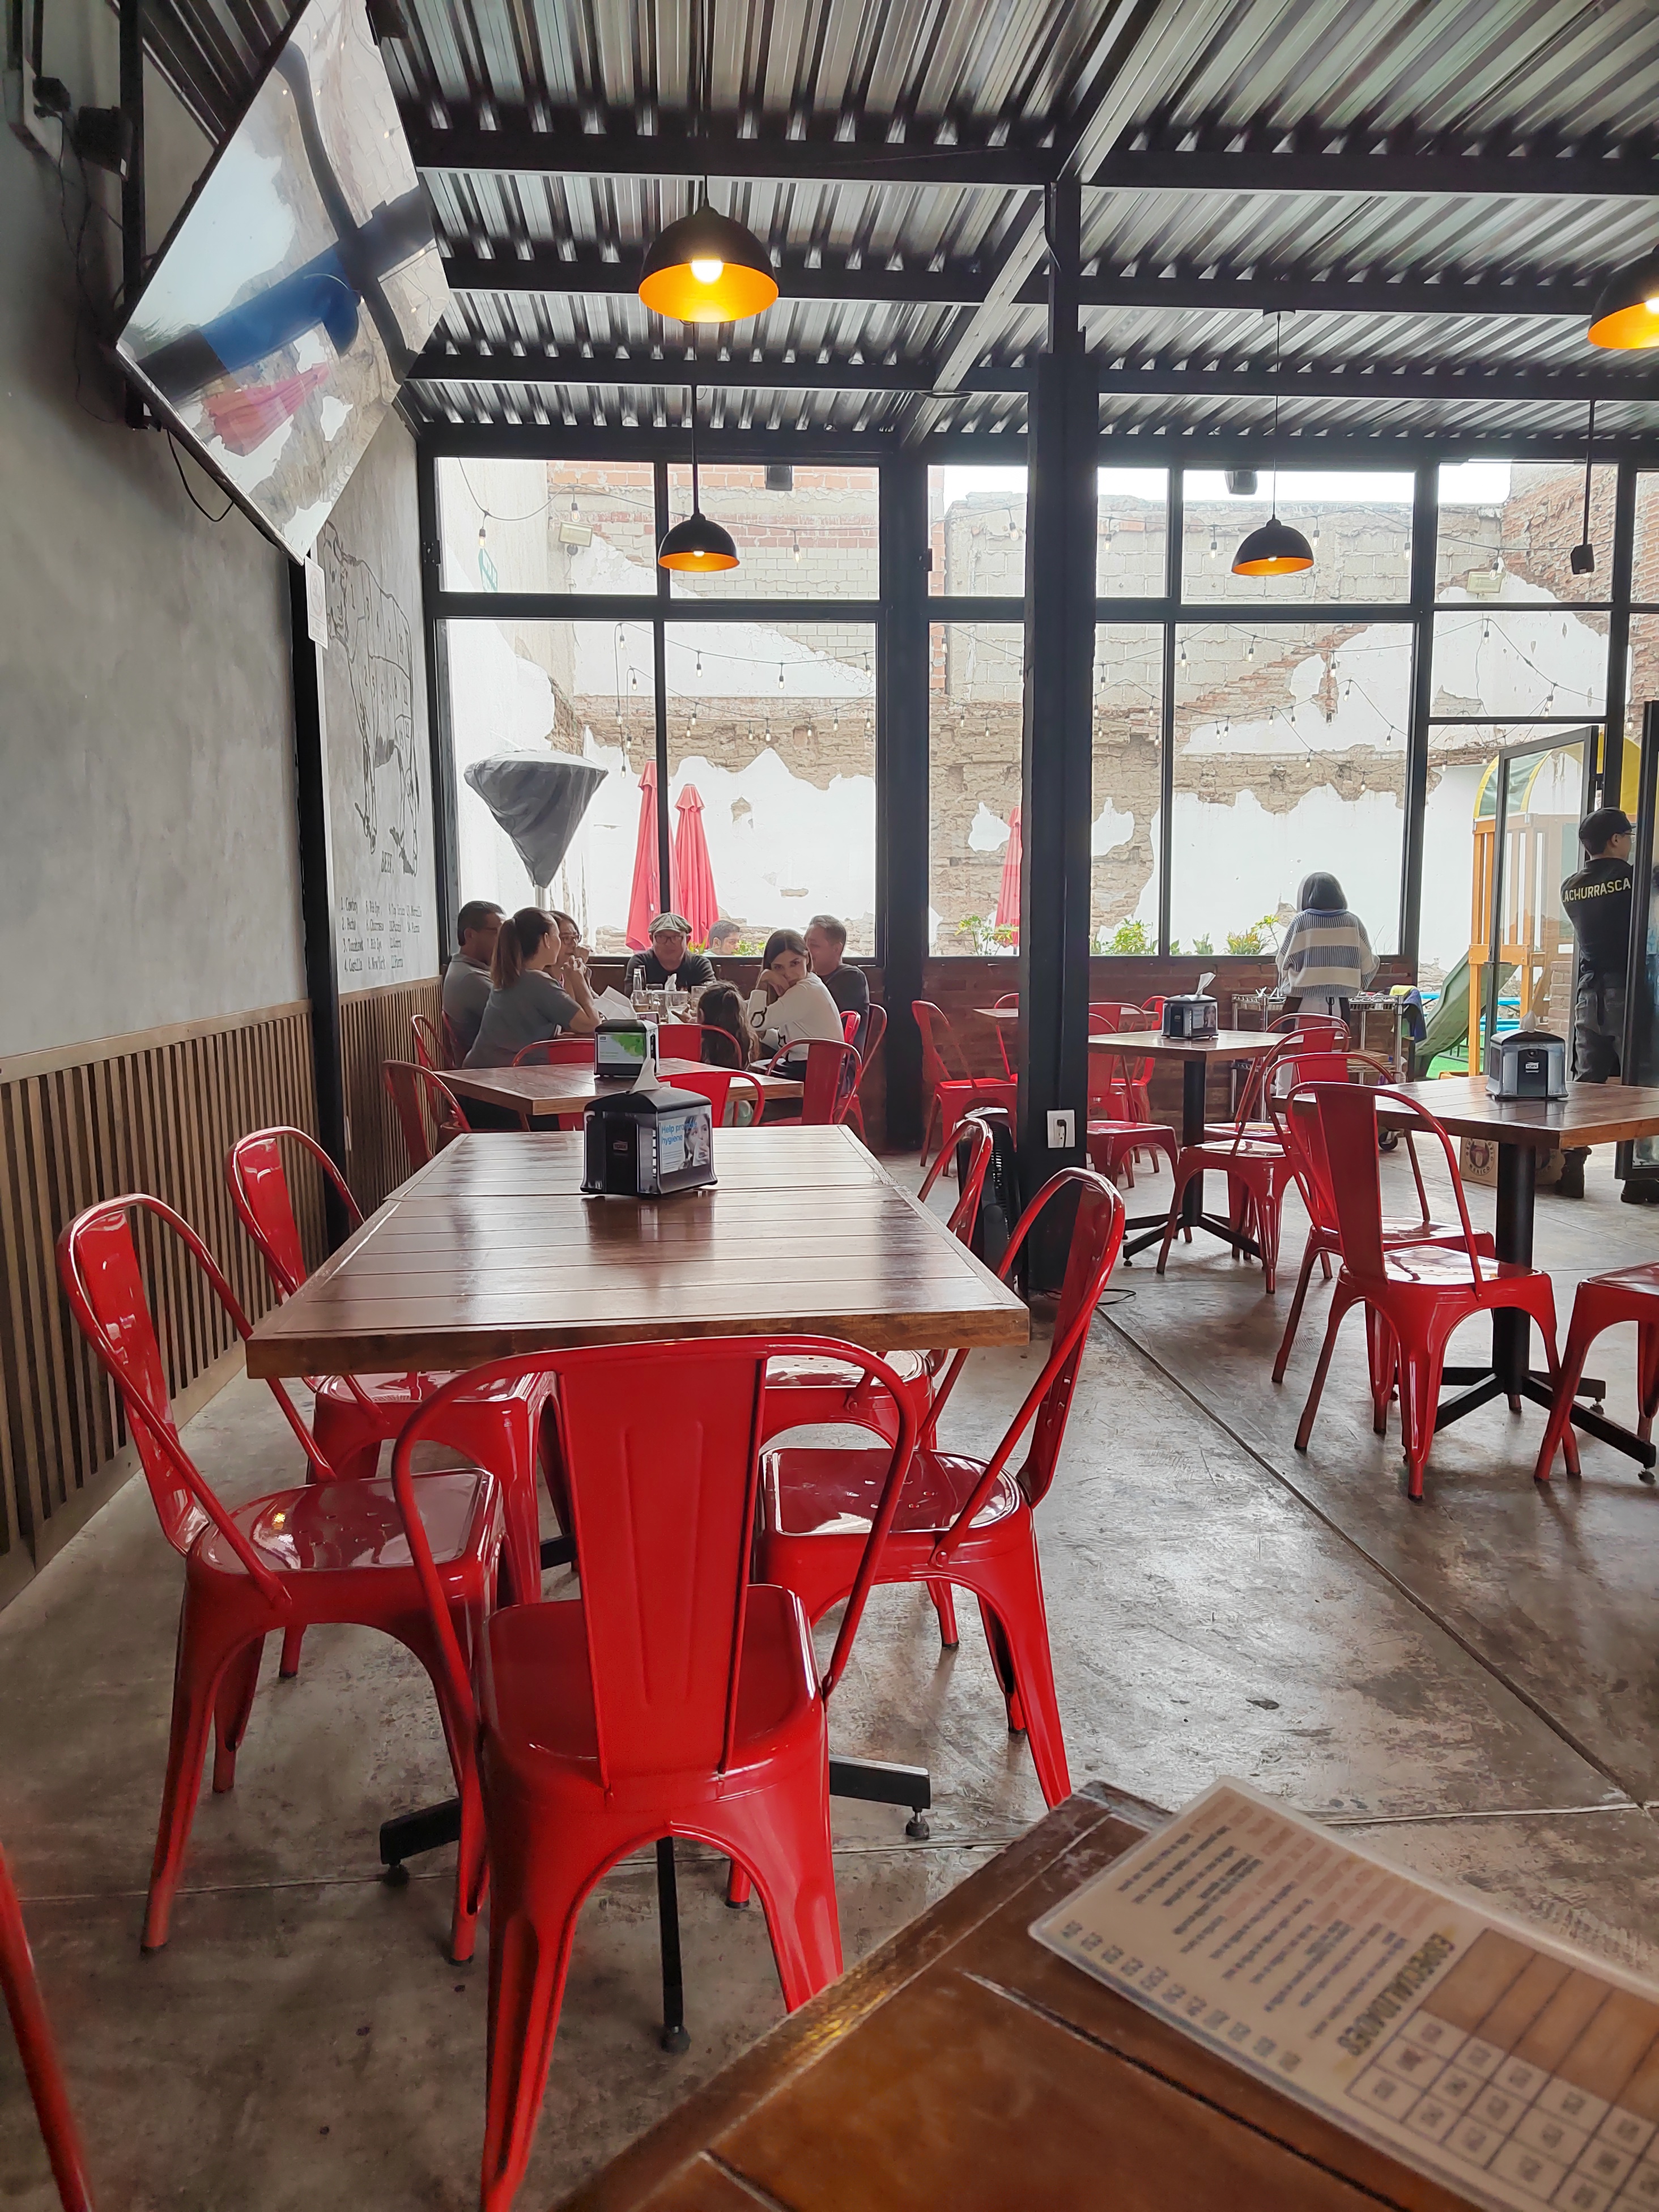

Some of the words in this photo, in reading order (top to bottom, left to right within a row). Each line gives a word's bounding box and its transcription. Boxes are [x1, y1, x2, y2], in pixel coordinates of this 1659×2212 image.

[661, 1125, 675, 1135] Help
[675, 1121, 697, 1133] promote
[662, 1135, 683, 1145] hygiene
